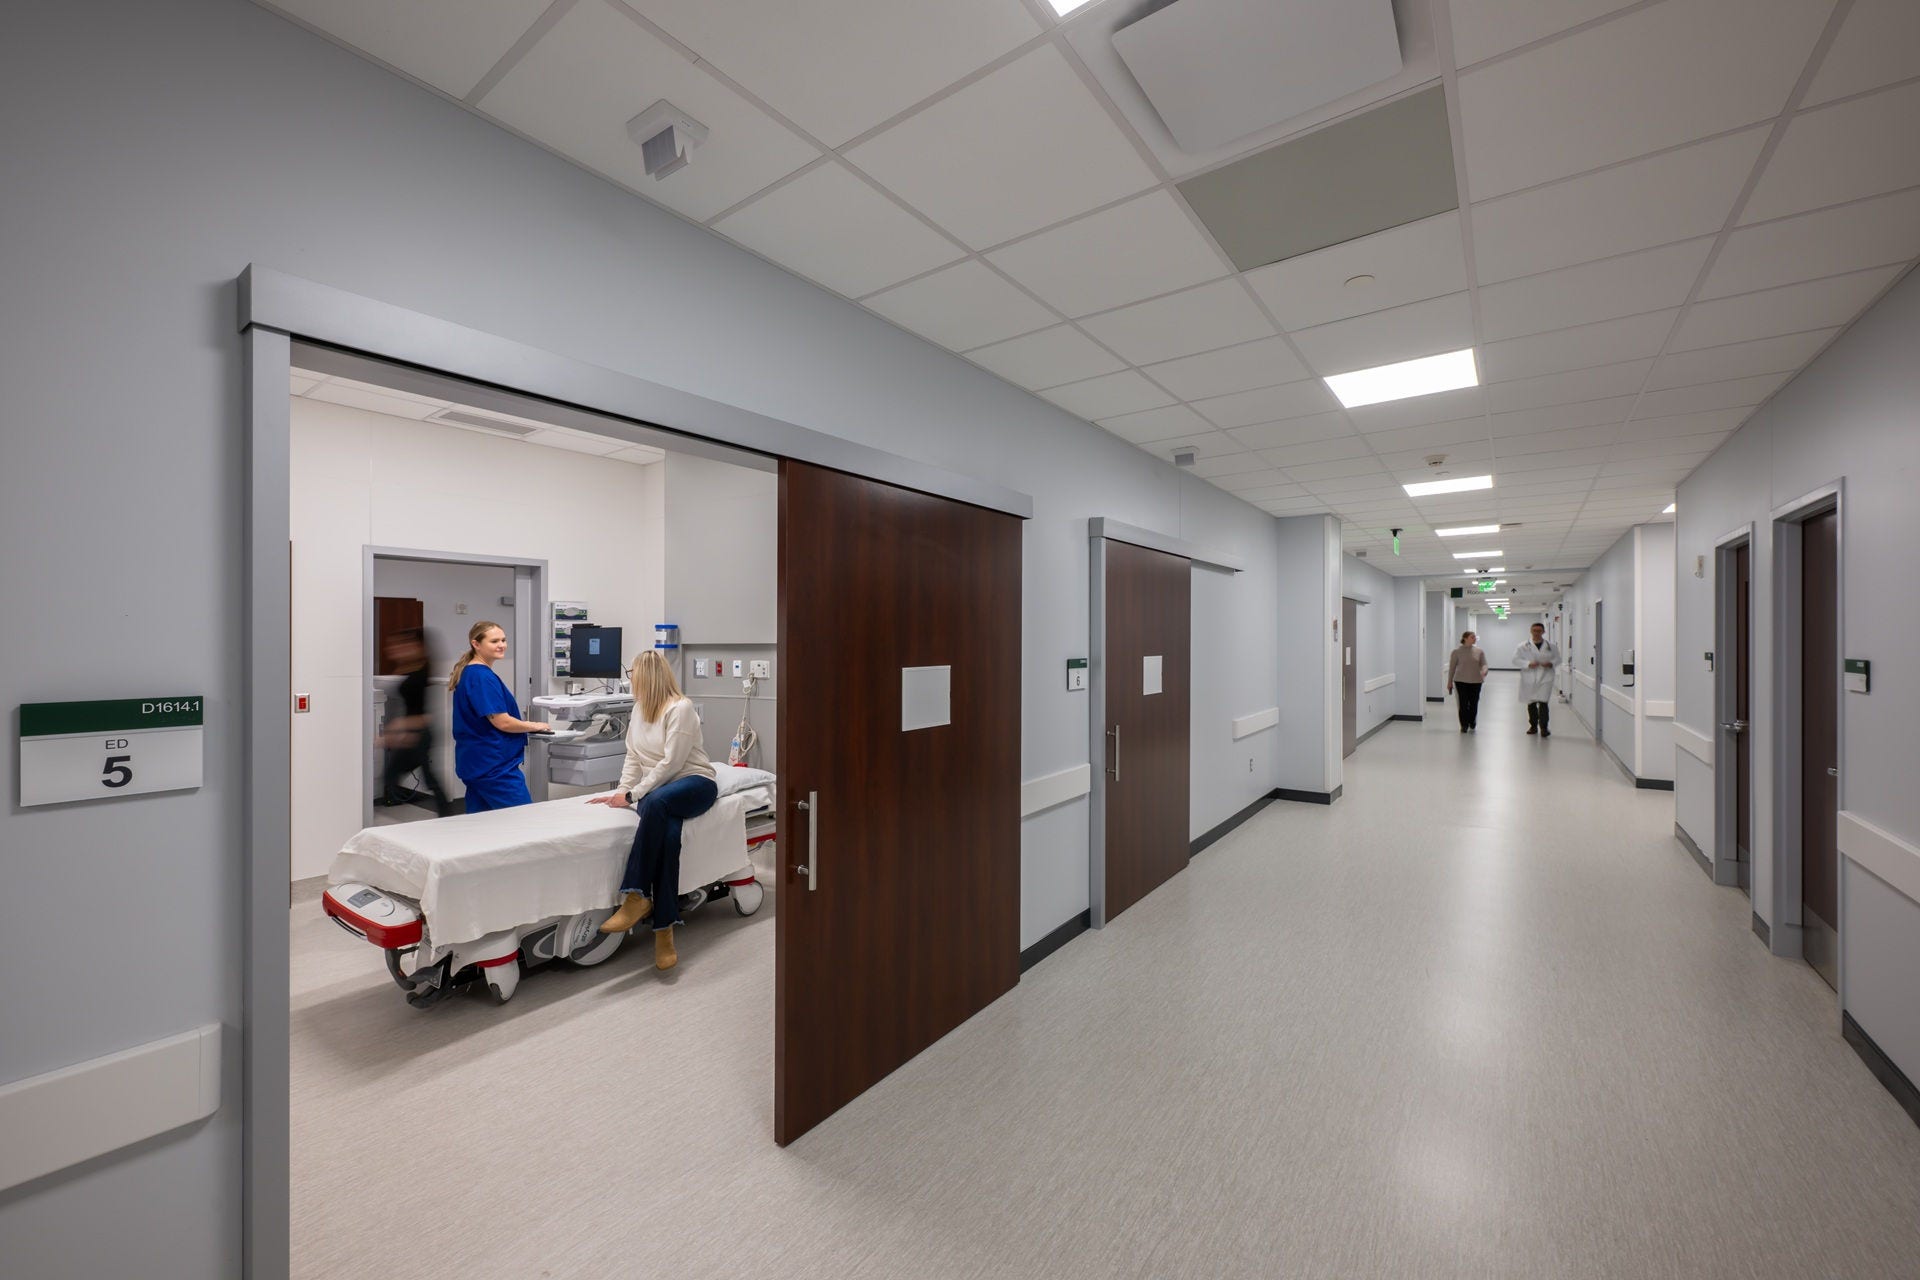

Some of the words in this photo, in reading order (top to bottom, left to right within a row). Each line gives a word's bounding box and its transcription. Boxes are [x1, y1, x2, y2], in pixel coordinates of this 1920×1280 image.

[1076, 675, 1081, 687] 6
[142, 701, 200, 714] D1614.1
[105, 738, 129, 750] ED
[101, 755, 133, 788] 5
